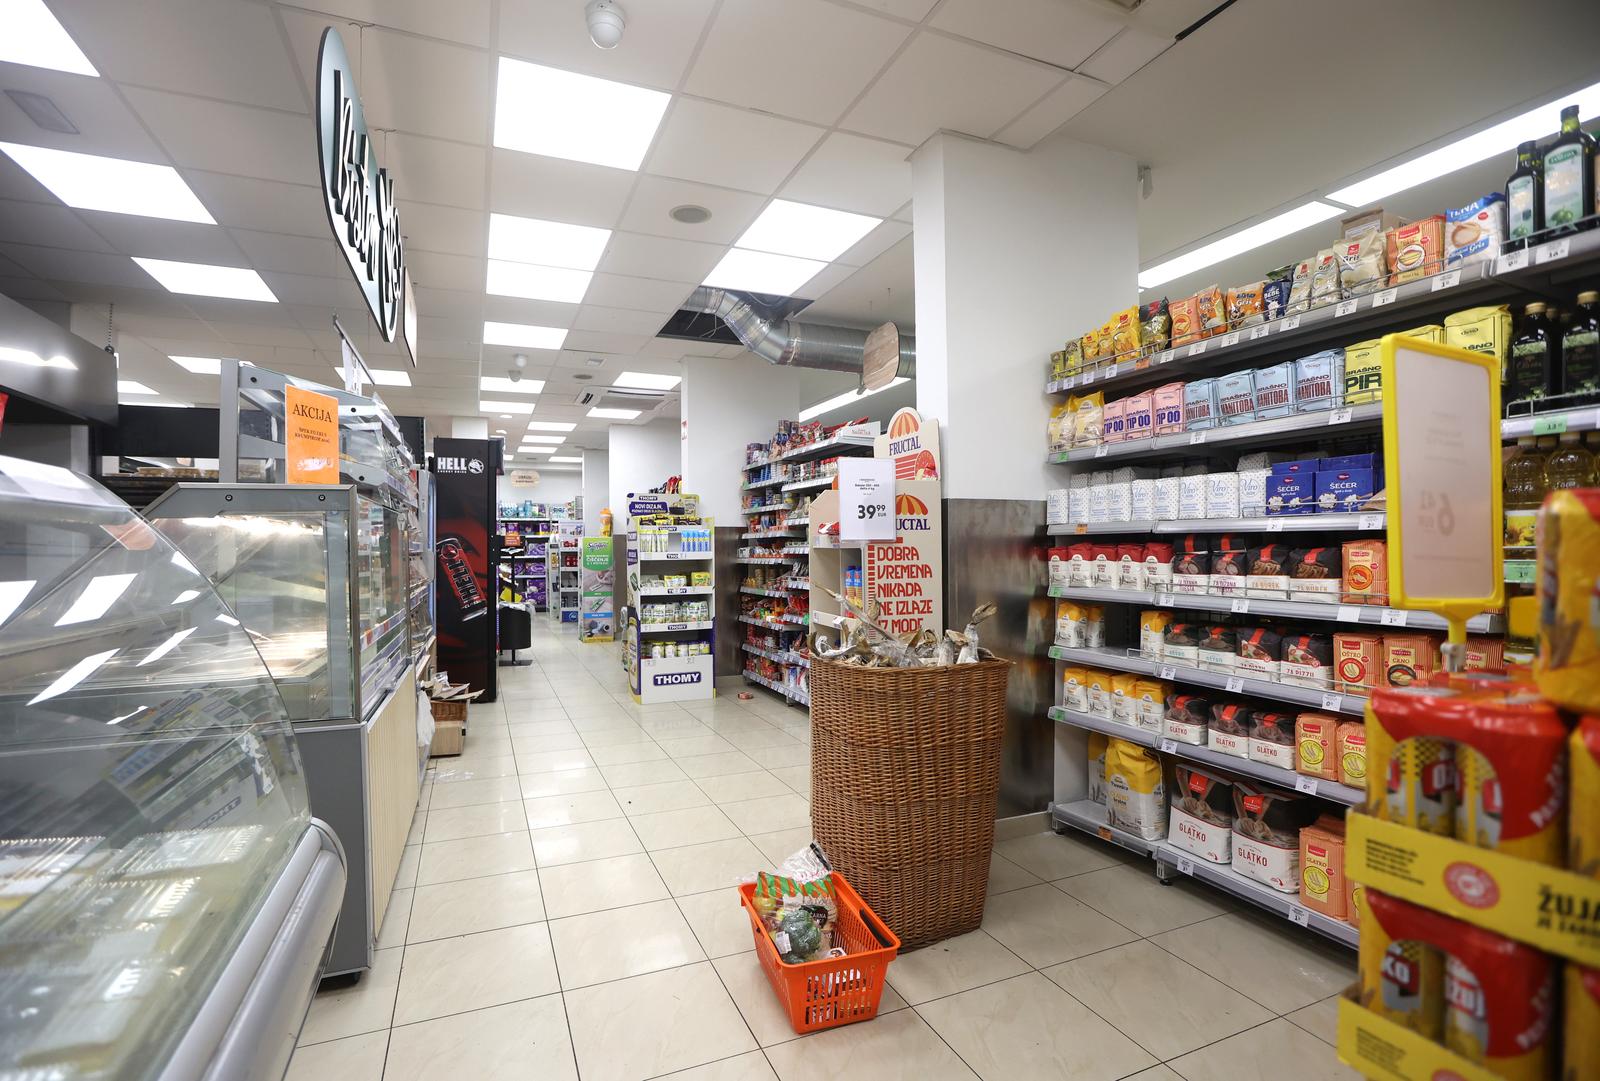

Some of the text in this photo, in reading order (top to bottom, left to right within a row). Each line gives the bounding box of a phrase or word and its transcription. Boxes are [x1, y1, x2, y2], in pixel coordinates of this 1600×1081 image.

[1345, 365, 1382, 376] BRAŠNO
[1297, 374, 1330, 385] BRAŠNO
[1345, 372, 1382, 394] PIR
[292, 403, 332, 423] AKCIJA
[889, 436, 921, 456] FRUCTAL
[437, 456, 468, 471] HELL
[857, 504, 876, 520] 39
[896, 518, 931, 532] UCTAL
[877, 546, 920, 562] DOBRA
[877, 564, 933, 580] VREMENA
[877, 582, 923, 598] NIKADA
[879, 599, 933, 616] NE IZLAZE
[655, 673, 700, 685] THOMY
[1169, 725, 1188, 736] GLATKO
[1215, 737, 1236, 748] GLATKO
[1256, 745, 1278, 757] GLATKO
[1178, 822, 1207, 843] GLATKO
[1237, 847, 1268, 867] GLATKO
[1306, 857, 1328, 868] GLATKO
